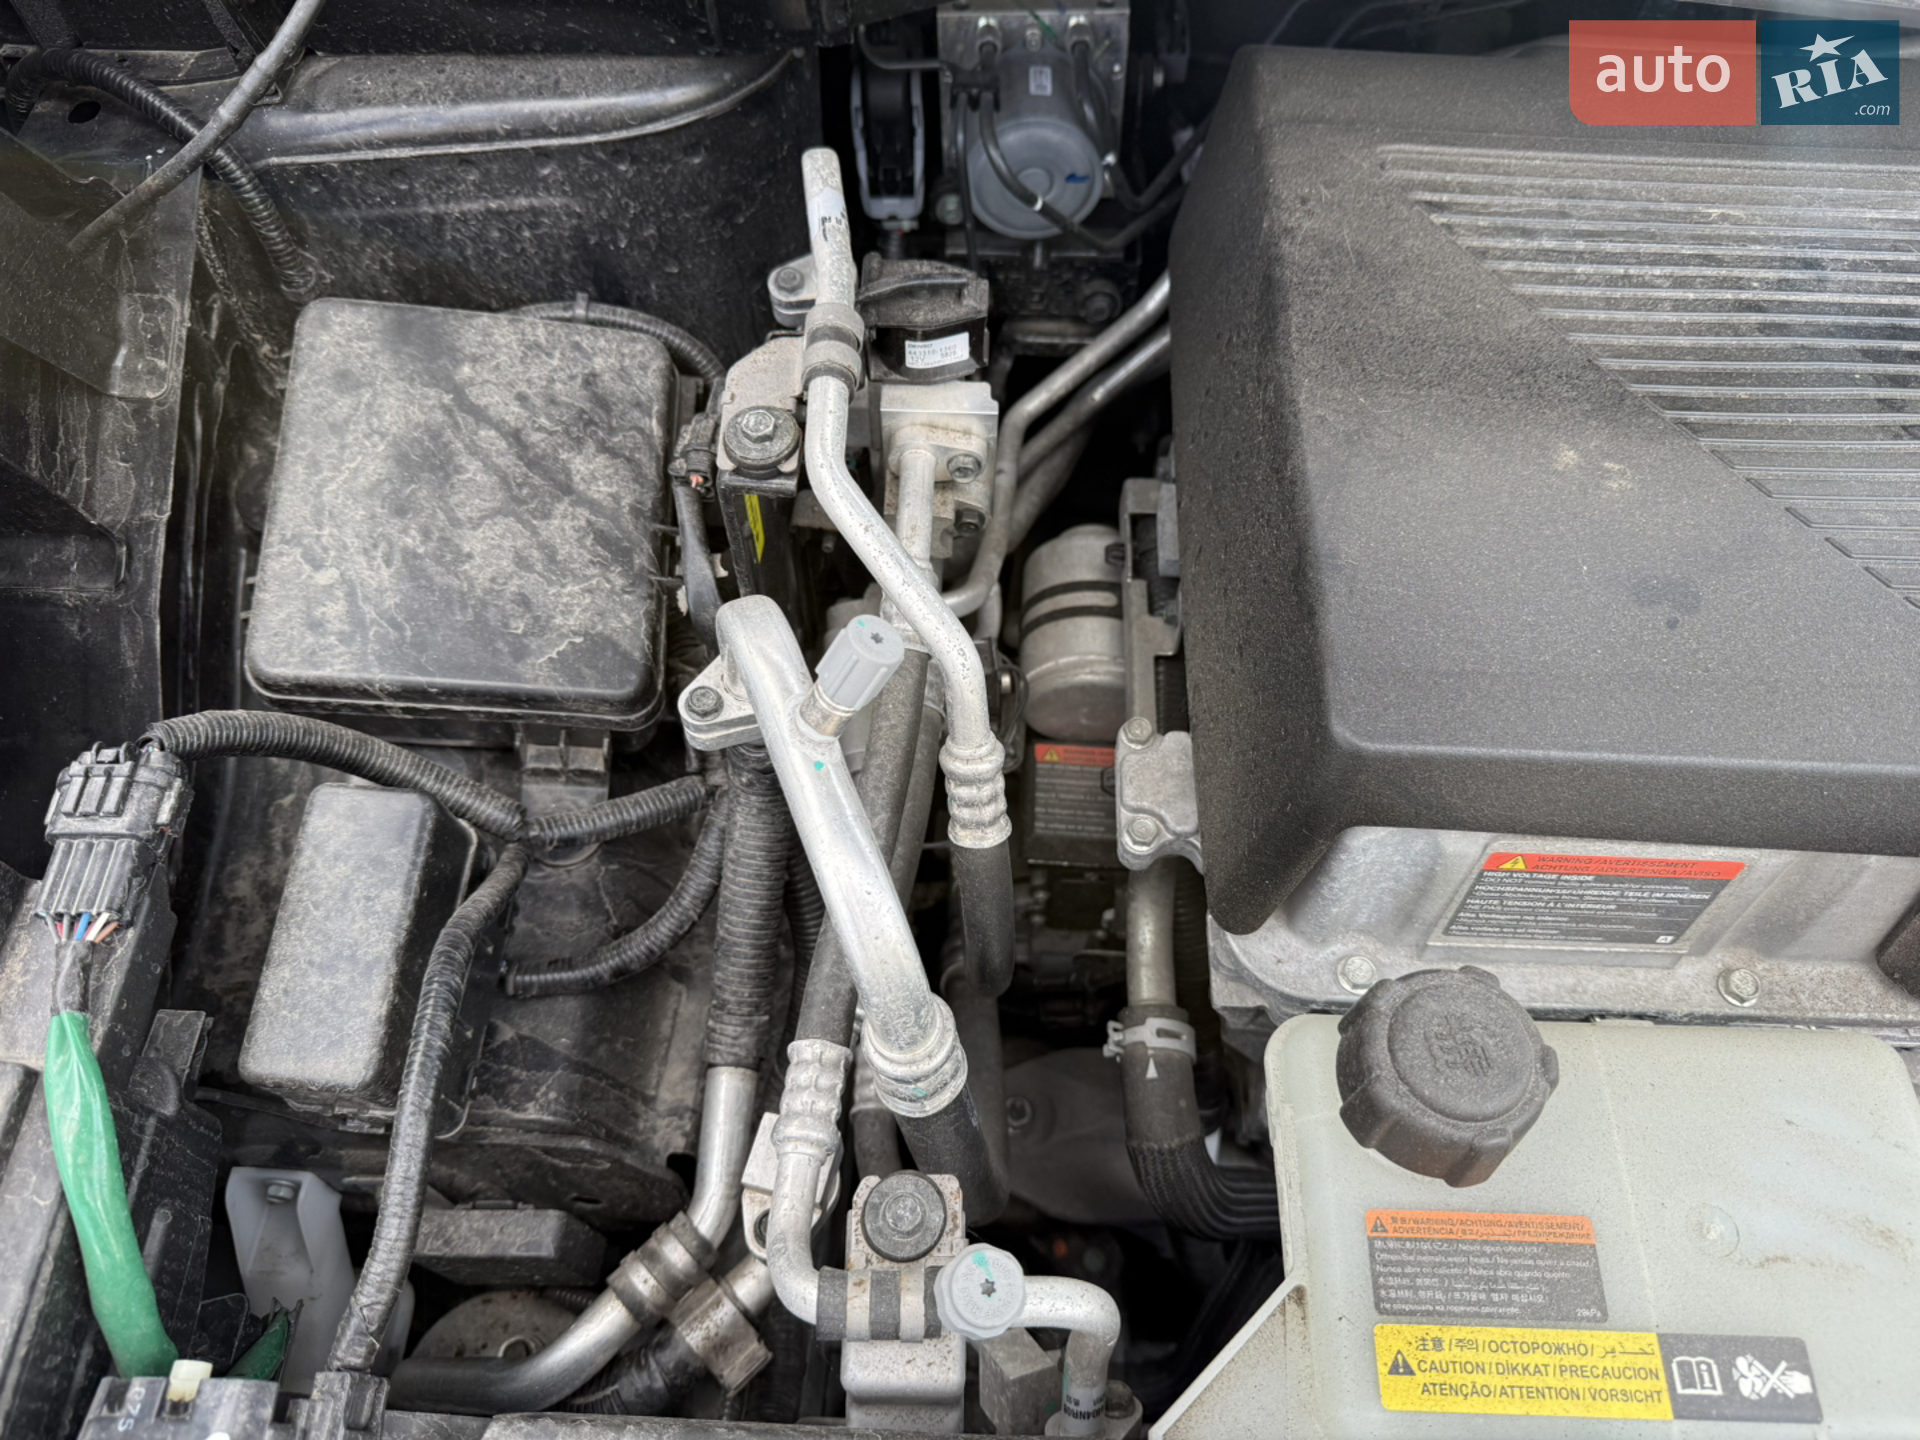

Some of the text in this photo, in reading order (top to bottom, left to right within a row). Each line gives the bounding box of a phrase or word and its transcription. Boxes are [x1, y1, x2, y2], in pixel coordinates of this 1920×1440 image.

[1537, 856, 1593, 864] WARNING
[1531, 864, 1591, 872] ACHTUNG
[1512, 872, 1559, 880] VOLTAGE
[1417, 1359, 1486, 1375] CAUTION
[1559, 1364, 1660, 1381] PRECAUCION
[1421, 1381, 1492, 1400] ATENÇÃO
[1499, 1385, 1580, 1401] ATTENTION
[1587, 1388, 1663, 1404] VORSICHT
